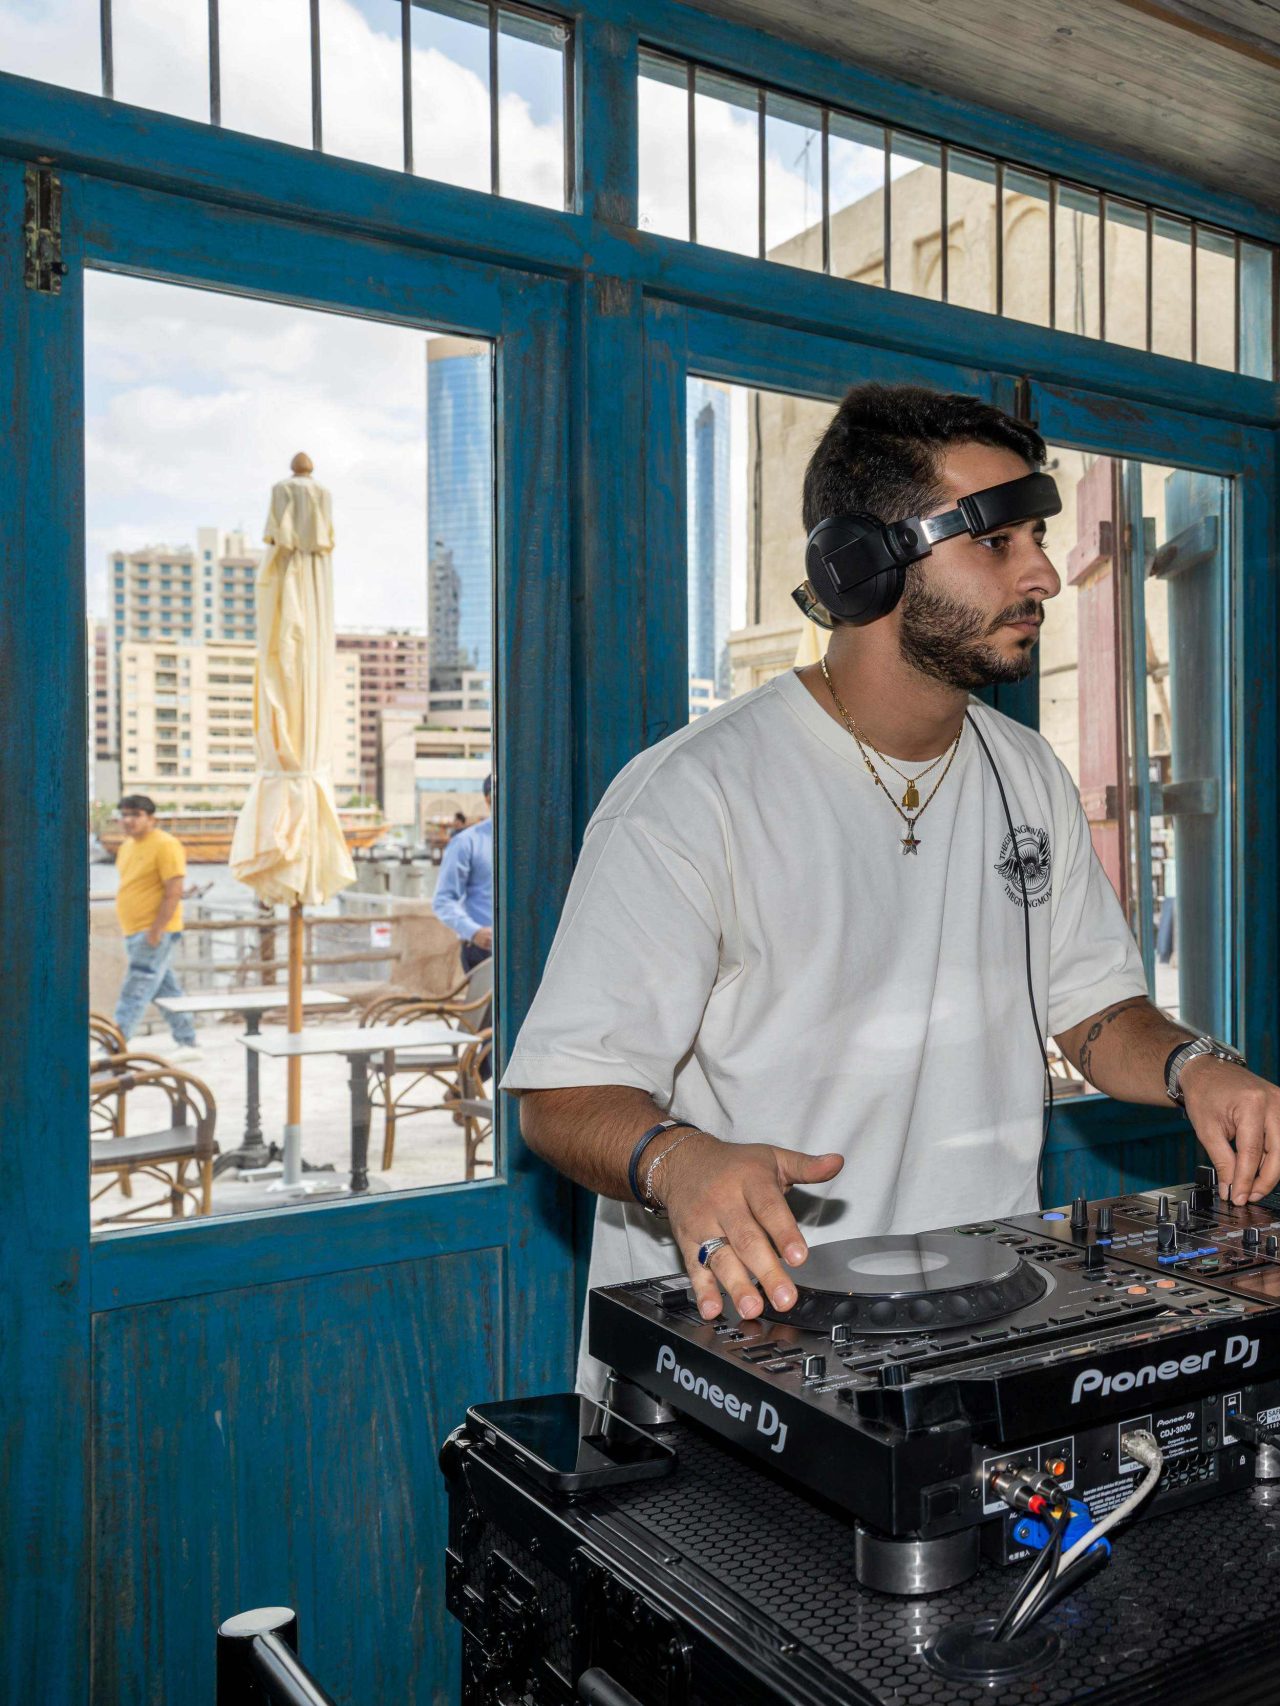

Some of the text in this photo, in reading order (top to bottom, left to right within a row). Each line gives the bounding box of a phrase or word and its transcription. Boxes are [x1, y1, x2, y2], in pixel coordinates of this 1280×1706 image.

[655, 1344, 753, 1422] Pioneer
[1071, 1350, 1217, 1405] Pioneer
[1156, 1414, 1186, 1428] Pioneer
[1159, 1423, 1192, 1439] CDJ-3000
